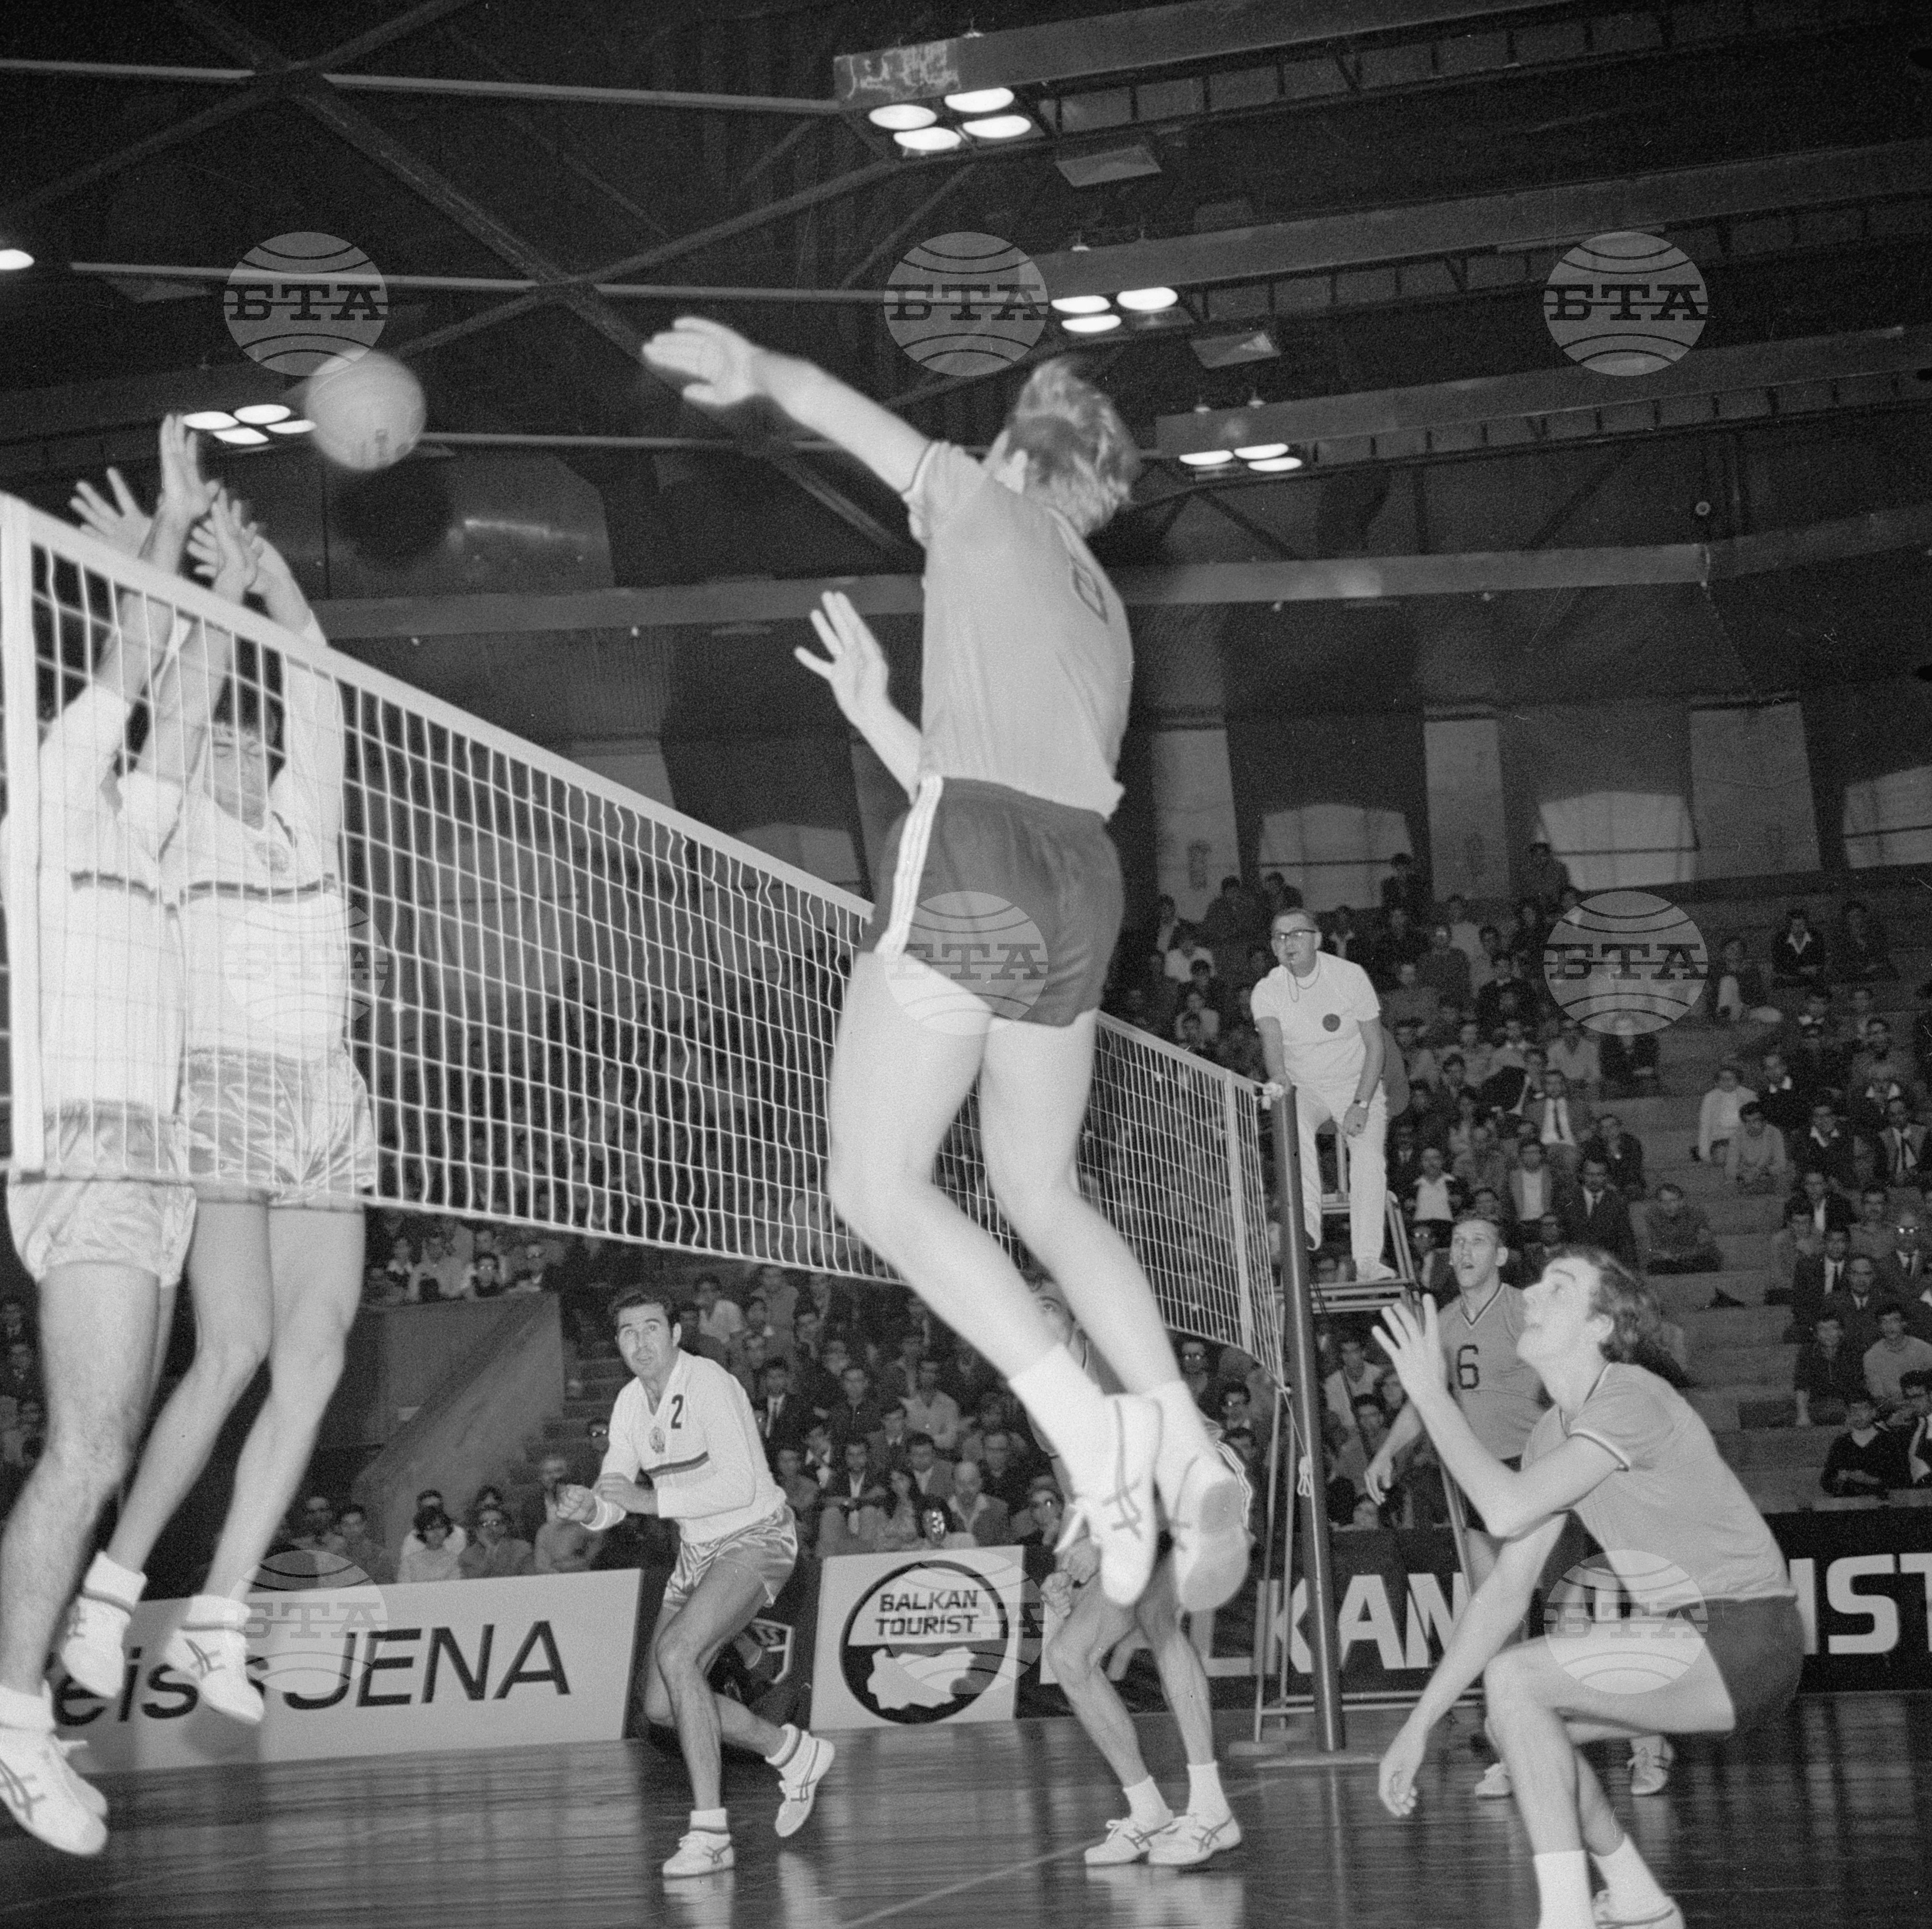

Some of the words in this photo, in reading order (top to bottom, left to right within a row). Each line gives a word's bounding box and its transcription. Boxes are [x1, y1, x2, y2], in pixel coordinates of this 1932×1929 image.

[1457, 1344, 1480, 1390] 6
[670, 1394, 683, 1429] 2
[879, 1589, 978, 1613] BALKAN
[874, 1614, 979, 1636] TOURIST
[45, 1646, 270, 1726] eis
[283, 1620, 571, 1710] JENA
